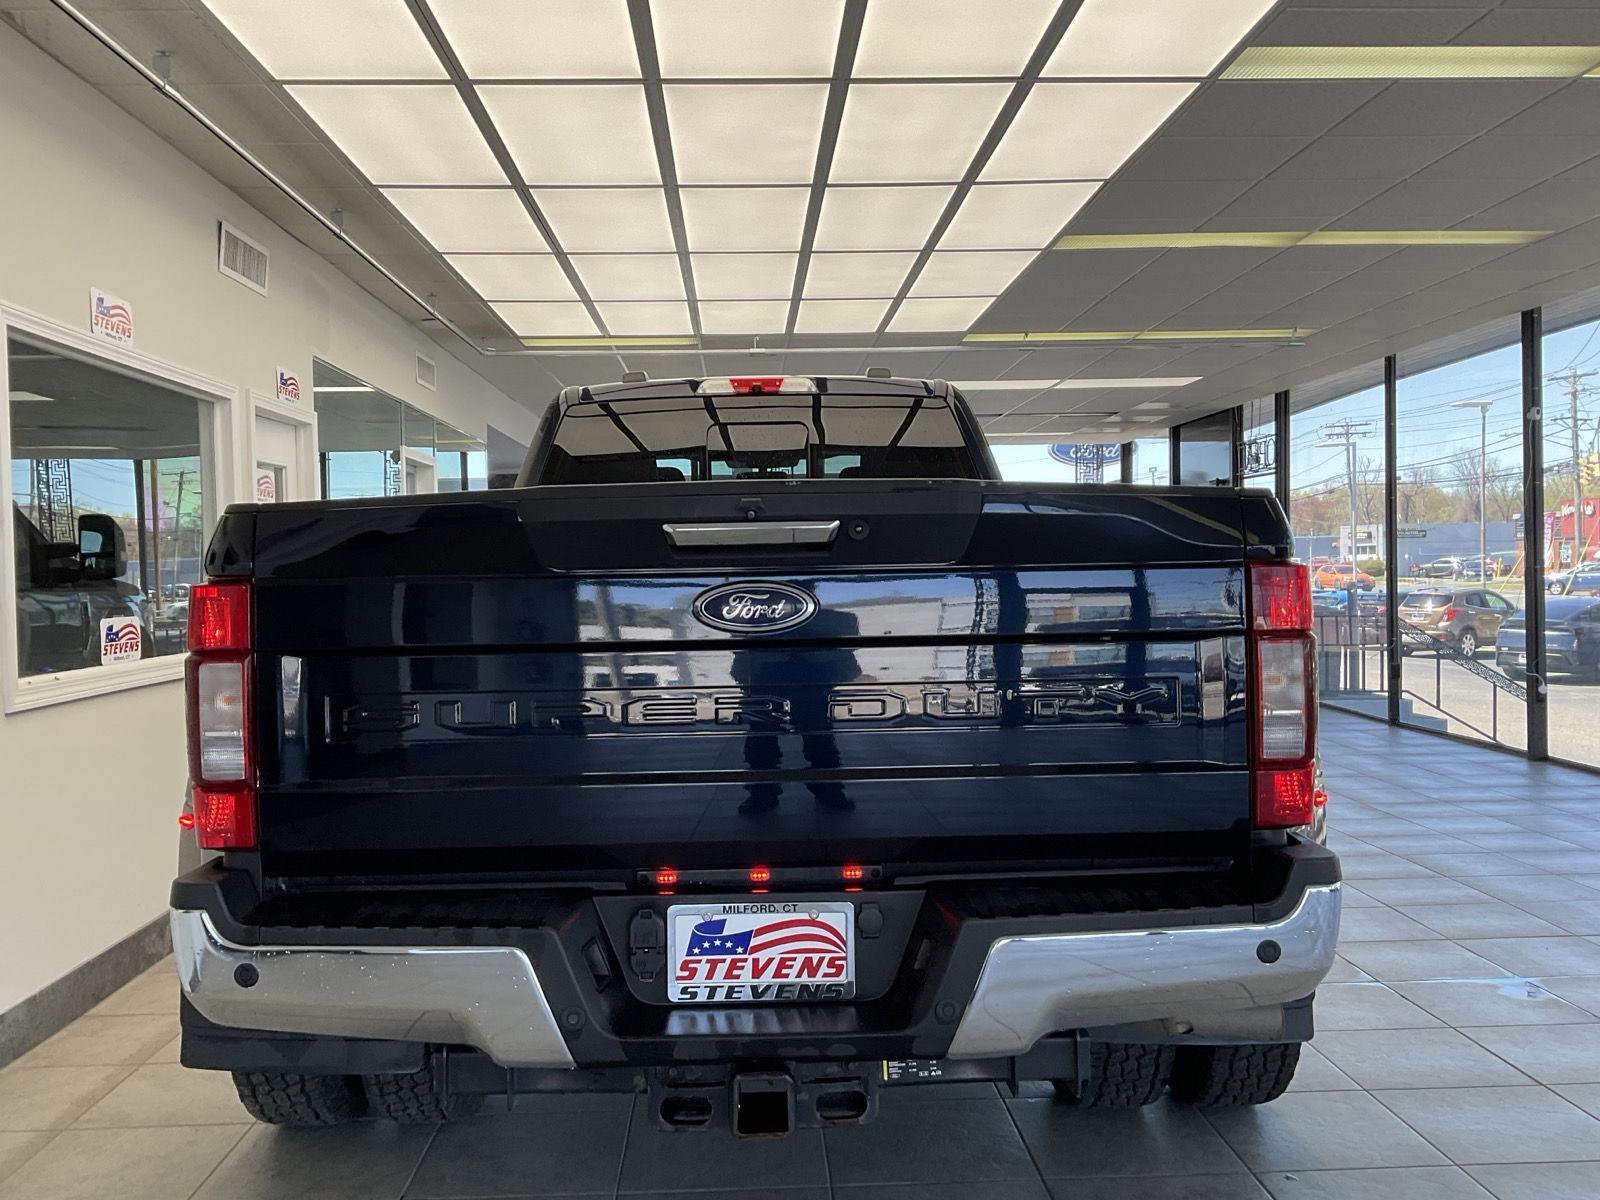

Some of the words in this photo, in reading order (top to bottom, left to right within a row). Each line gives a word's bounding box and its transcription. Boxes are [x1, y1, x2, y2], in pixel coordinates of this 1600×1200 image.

[94, 314, 132, 338] STEVENS
[279, 385, 300, 400] STEVENS
[722, 593, 786, 620] Ford
[103, 641, 140, 656] STEVENS
[782, 903, 799, 913] CT
[676, 956, 847, 981] STEVENS
[678, 983, 845, 1000] STEVENS
